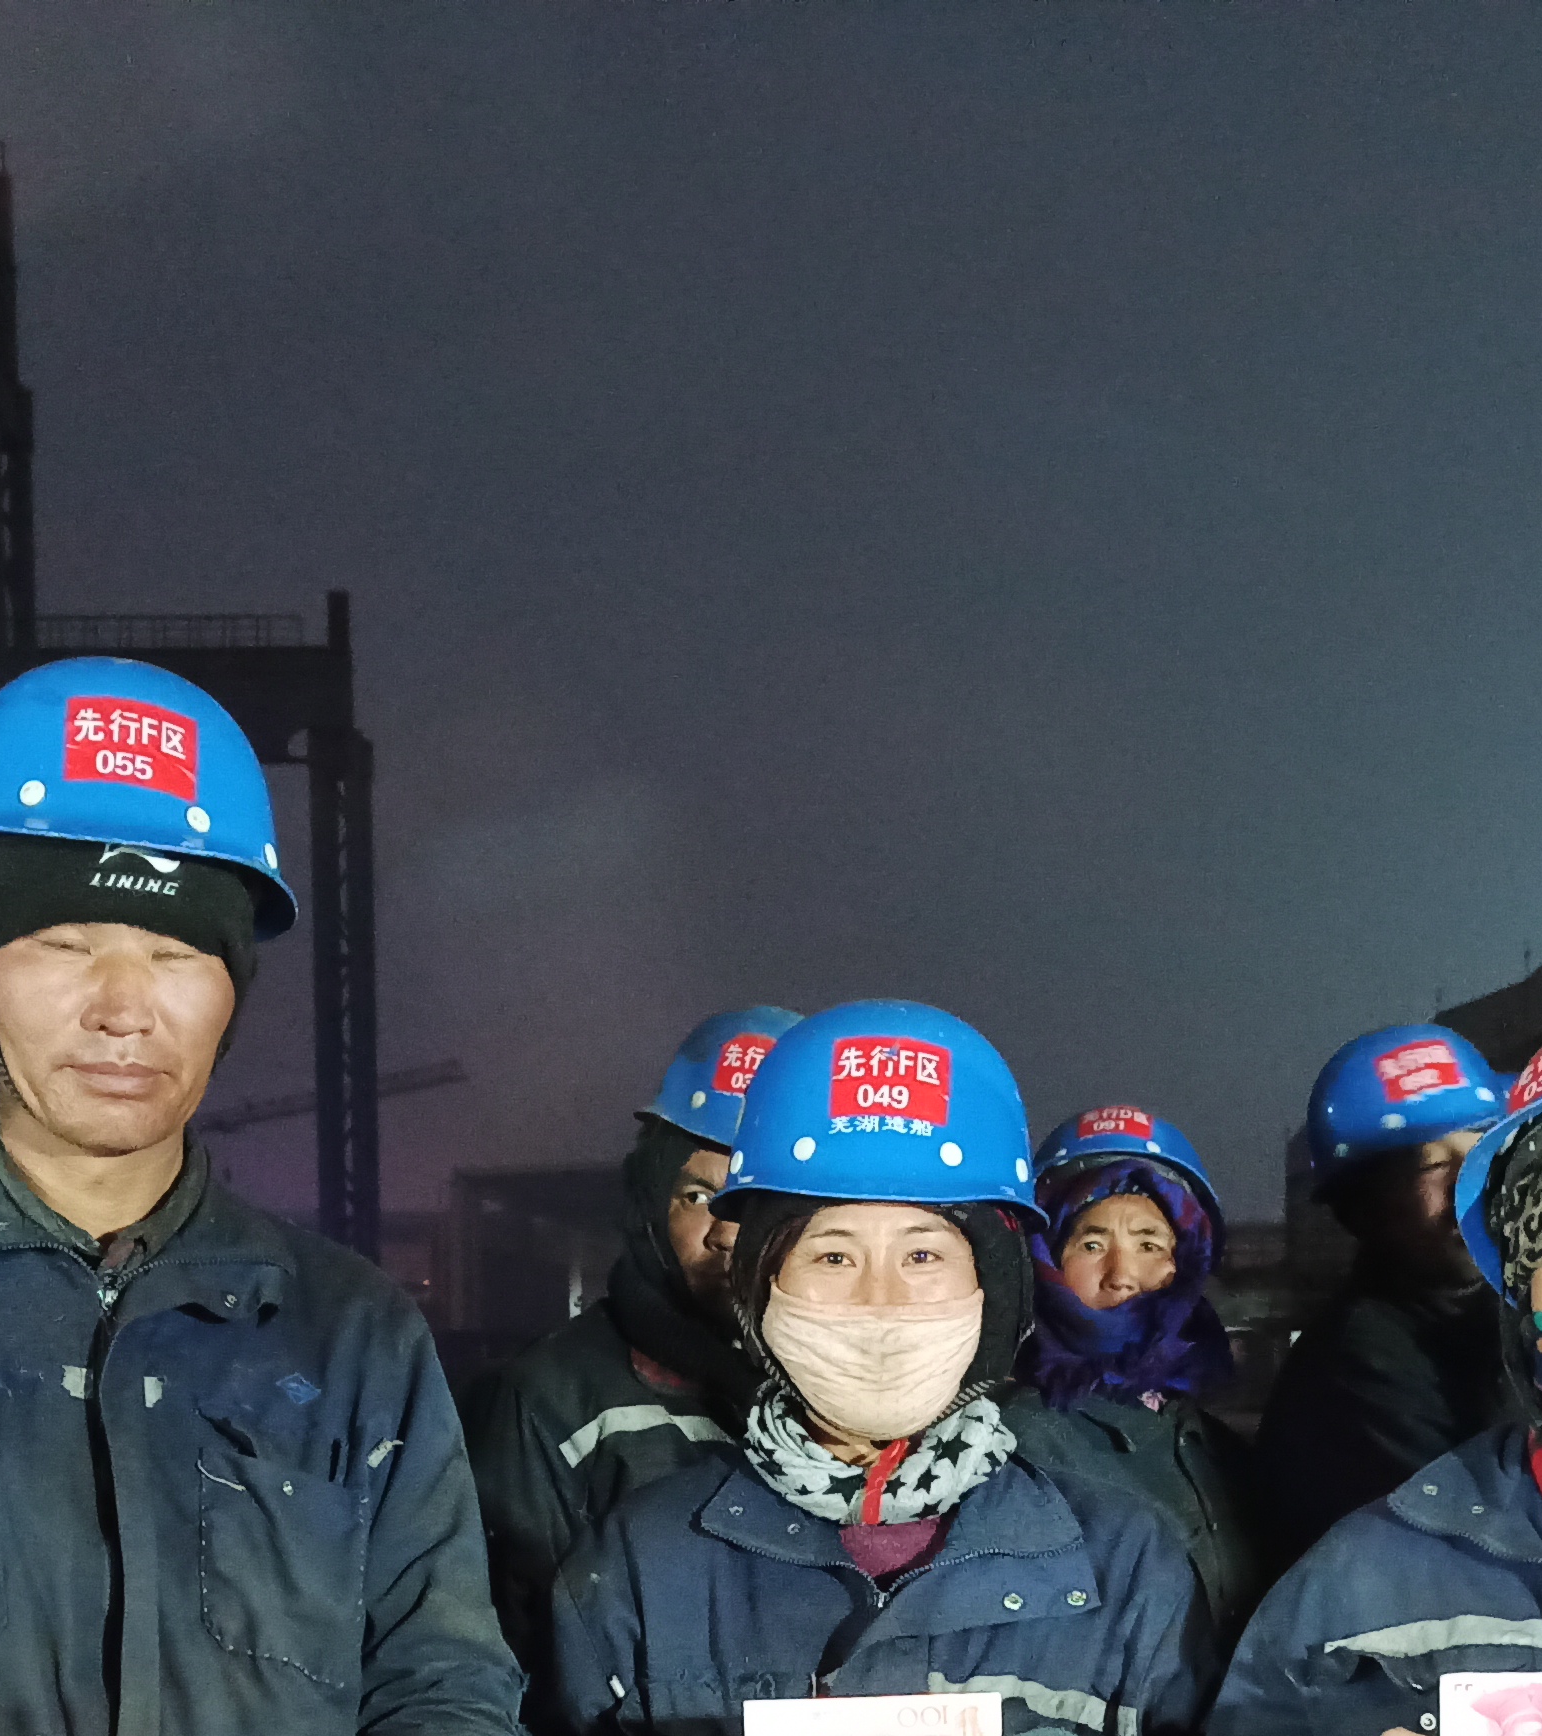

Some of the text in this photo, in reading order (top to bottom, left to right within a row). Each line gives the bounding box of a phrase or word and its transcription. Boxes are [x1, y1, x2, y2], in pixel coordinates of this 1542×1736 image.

[73, 707, 187, 760] 先行F区
[94, 749, 154, 780] 055
[88, 871, 179, 896] LINING
[837, 1045, 941, 1085] 先行F区
[856, 1084, 910, 1109] 049
